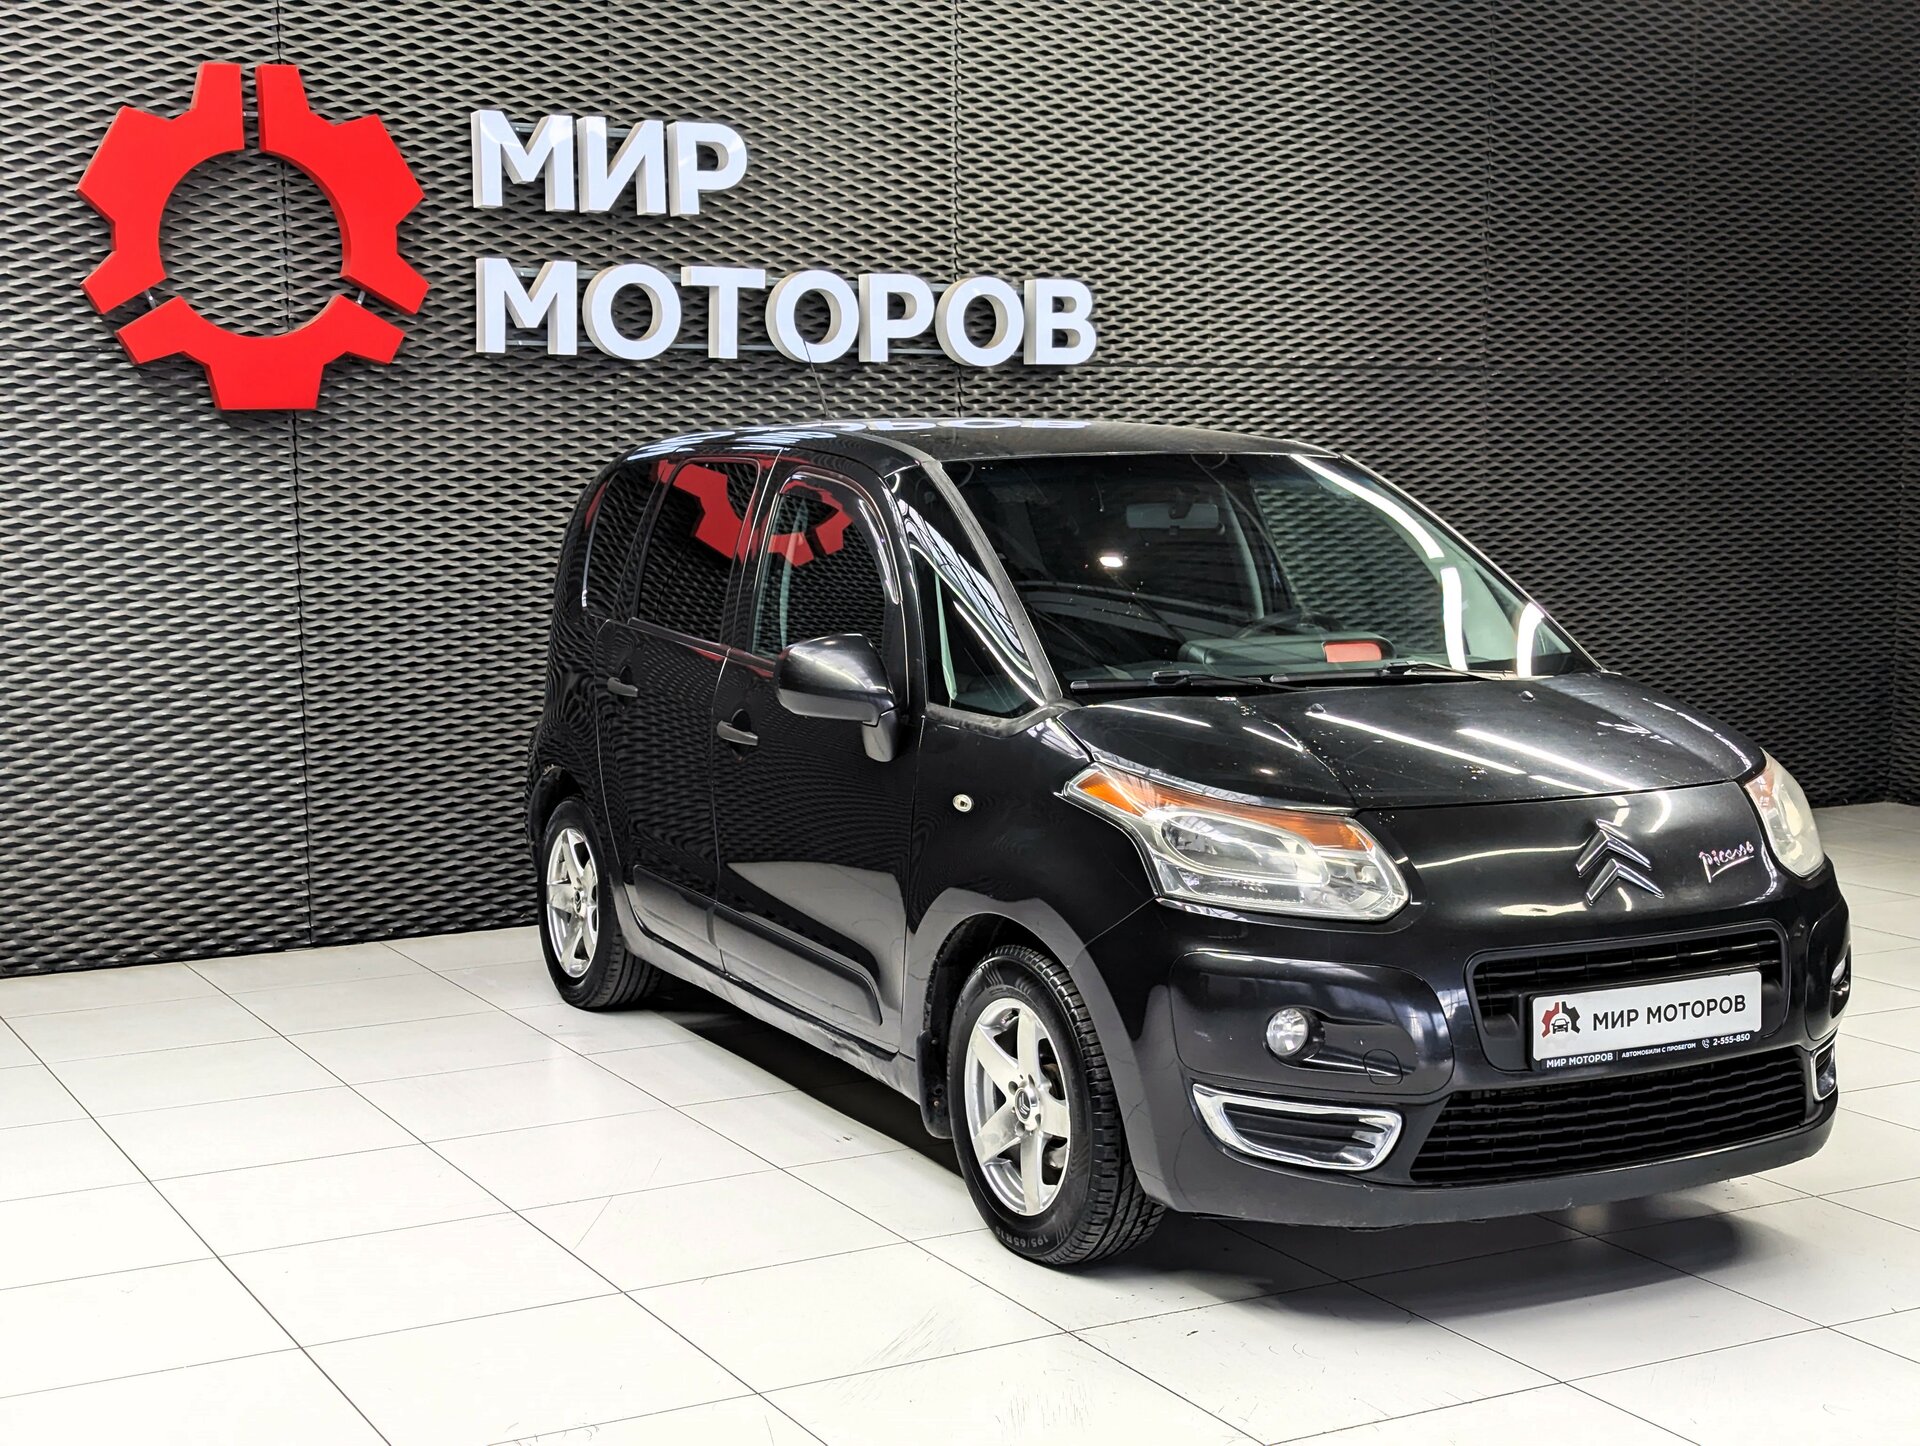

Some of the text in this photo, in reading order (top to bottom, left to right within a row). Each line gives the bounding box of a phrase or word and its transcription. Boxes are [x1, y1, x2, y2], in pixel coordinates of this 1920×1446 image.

[471, 109, 748, 216] МИР
[475, 257, 1097, 367] МОТОРОВ
[1593, 994, 1746, 1031] МИР МОТОРОВ
[1621, 1047, 1661, 1059] АВТОМОБИЛИ
[1667, 1042, 1696, 1052] ПРОБЕГОМ
[1713, 1033, 1750, 1046] 2-555-850
[1546, 1052, 1613, 1068] МИР МОТОРОВ
